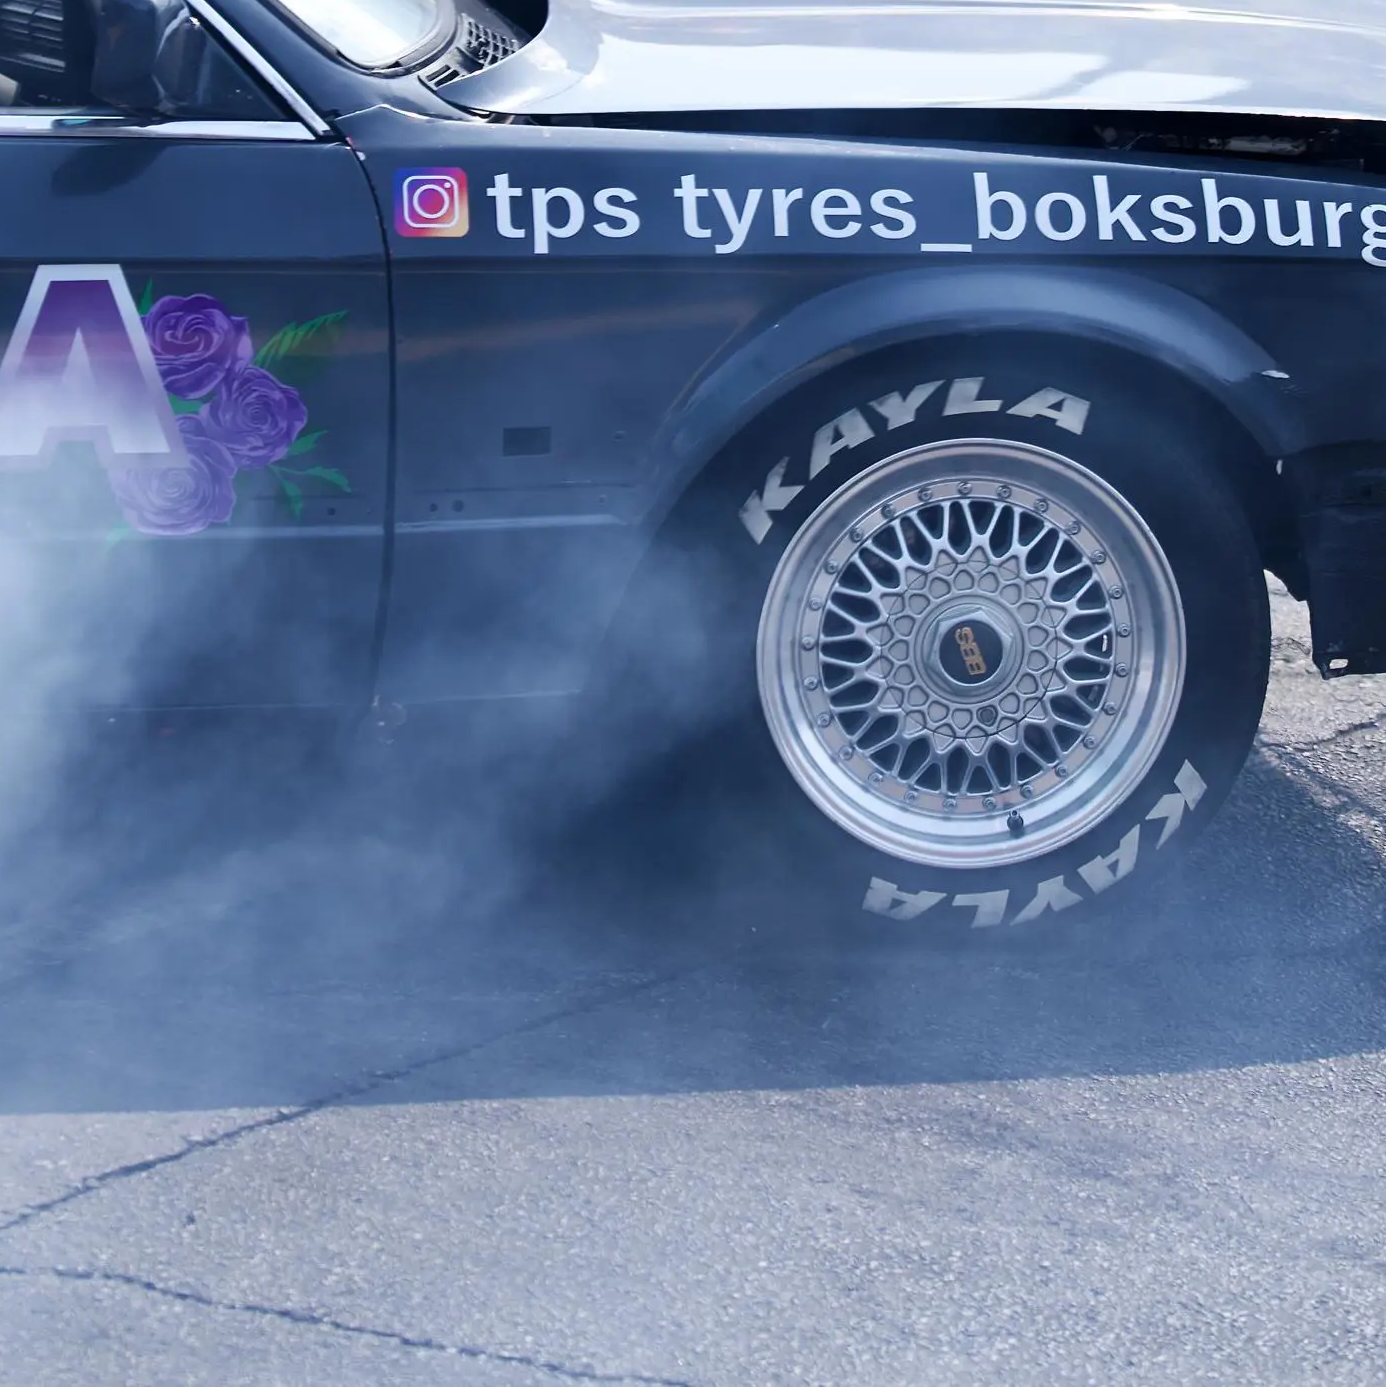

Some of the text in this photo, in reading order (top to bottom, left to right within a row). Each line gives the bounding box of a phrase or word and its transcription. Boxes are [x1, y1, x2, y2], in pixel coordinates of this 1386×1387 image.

[486, 173, 641, 254] tps
[738, 376, 1092, 545] KAYLA
[862, 759, 1208, 929] KAYLA
